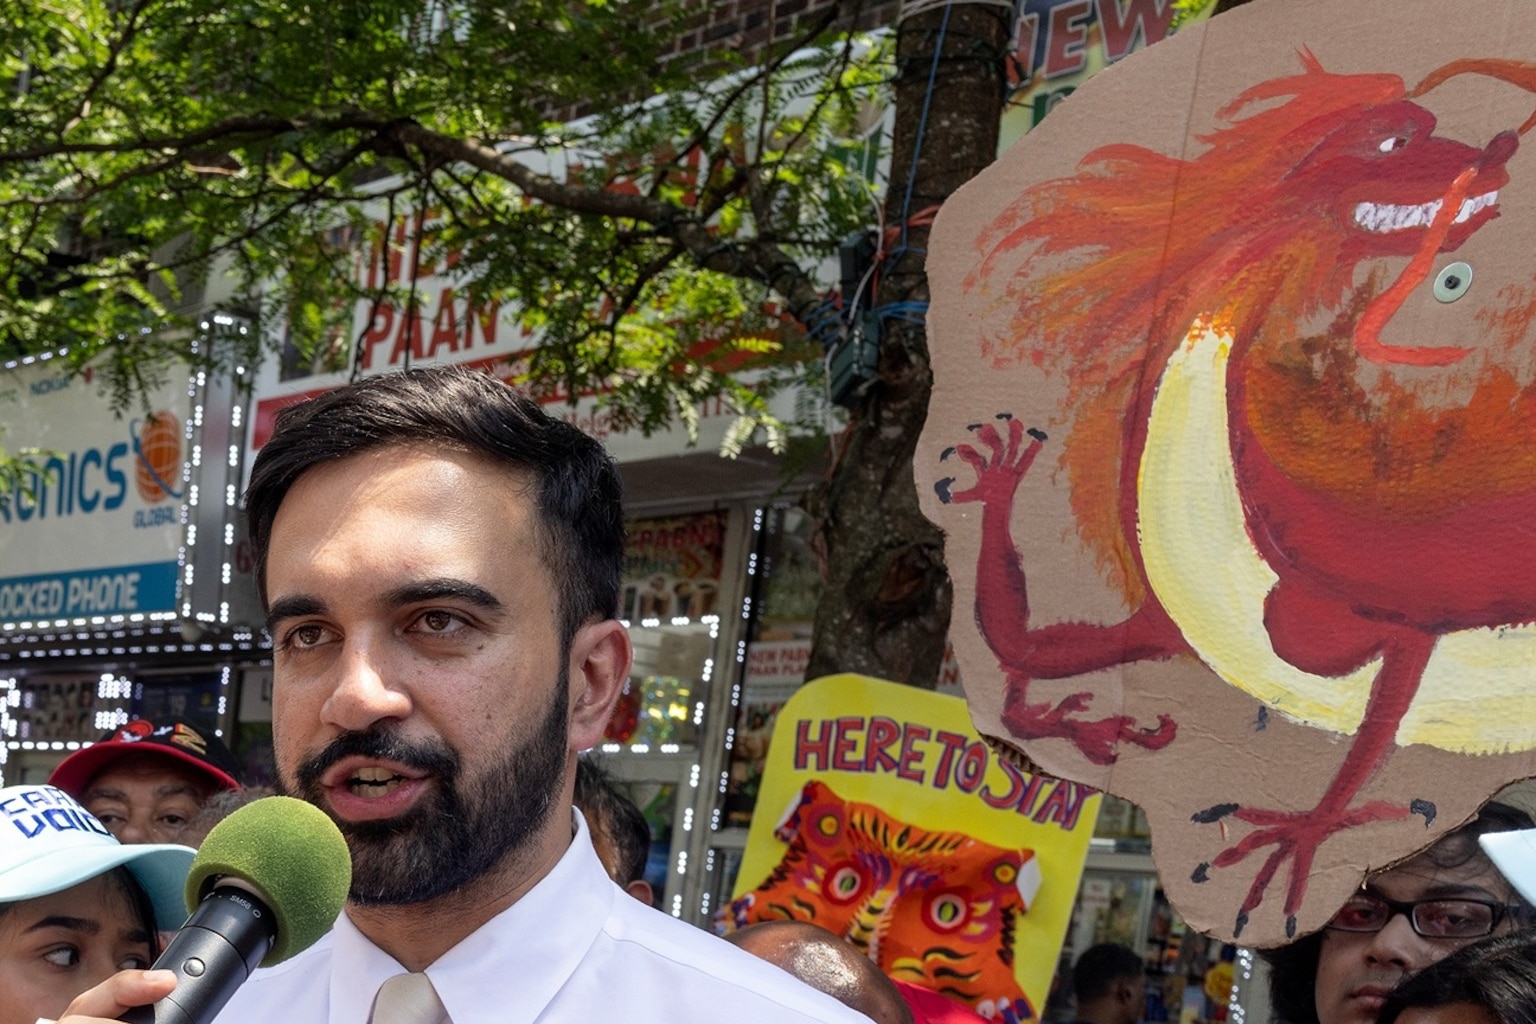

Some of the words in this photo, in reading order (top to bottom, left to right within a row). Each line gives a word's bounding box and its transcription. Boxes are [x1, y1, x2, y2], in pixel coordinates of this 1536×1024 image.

[361, 287, 500, 369] PAAN
[134, 507, 176, 529] GLOBAL
[66, 572, 141, 613] PHONE
[795, 716, 931, 784] HERE
[933, 730, 987, 794] TO
[979, 756, 1099, 831] STAY
[12, 807, 112, 839] VOIC
[230, 894, 252, 911] SM58
